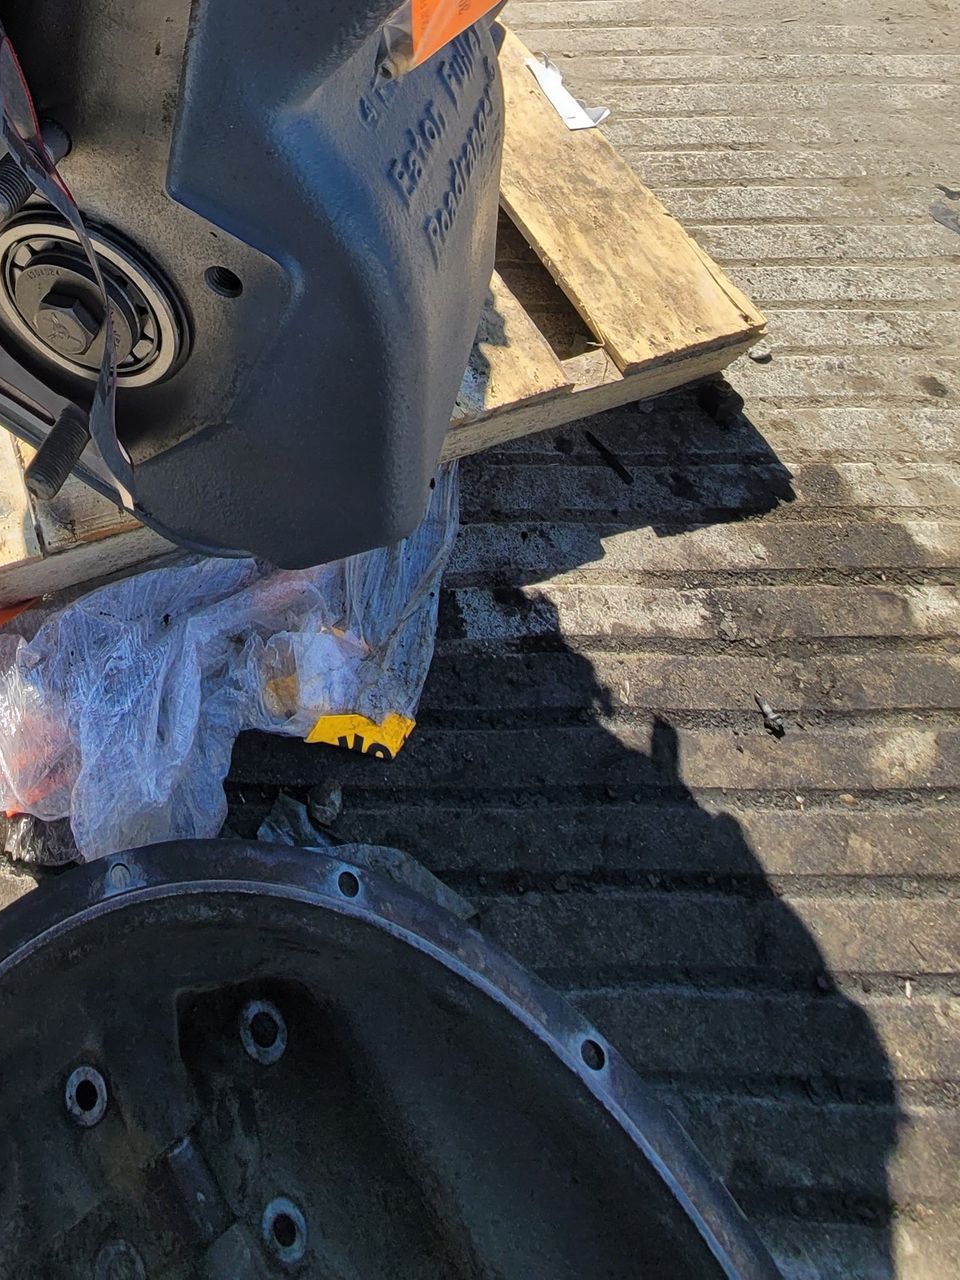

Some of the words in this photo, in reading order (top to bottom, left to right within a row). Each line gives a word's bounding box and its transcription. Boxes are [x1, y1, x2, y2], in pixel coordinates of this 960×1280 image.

[388, 99, 449, 211] Eaton
[439, 21, 481, 116] Fuller
[423, 82, 495, 270] Roadranger
